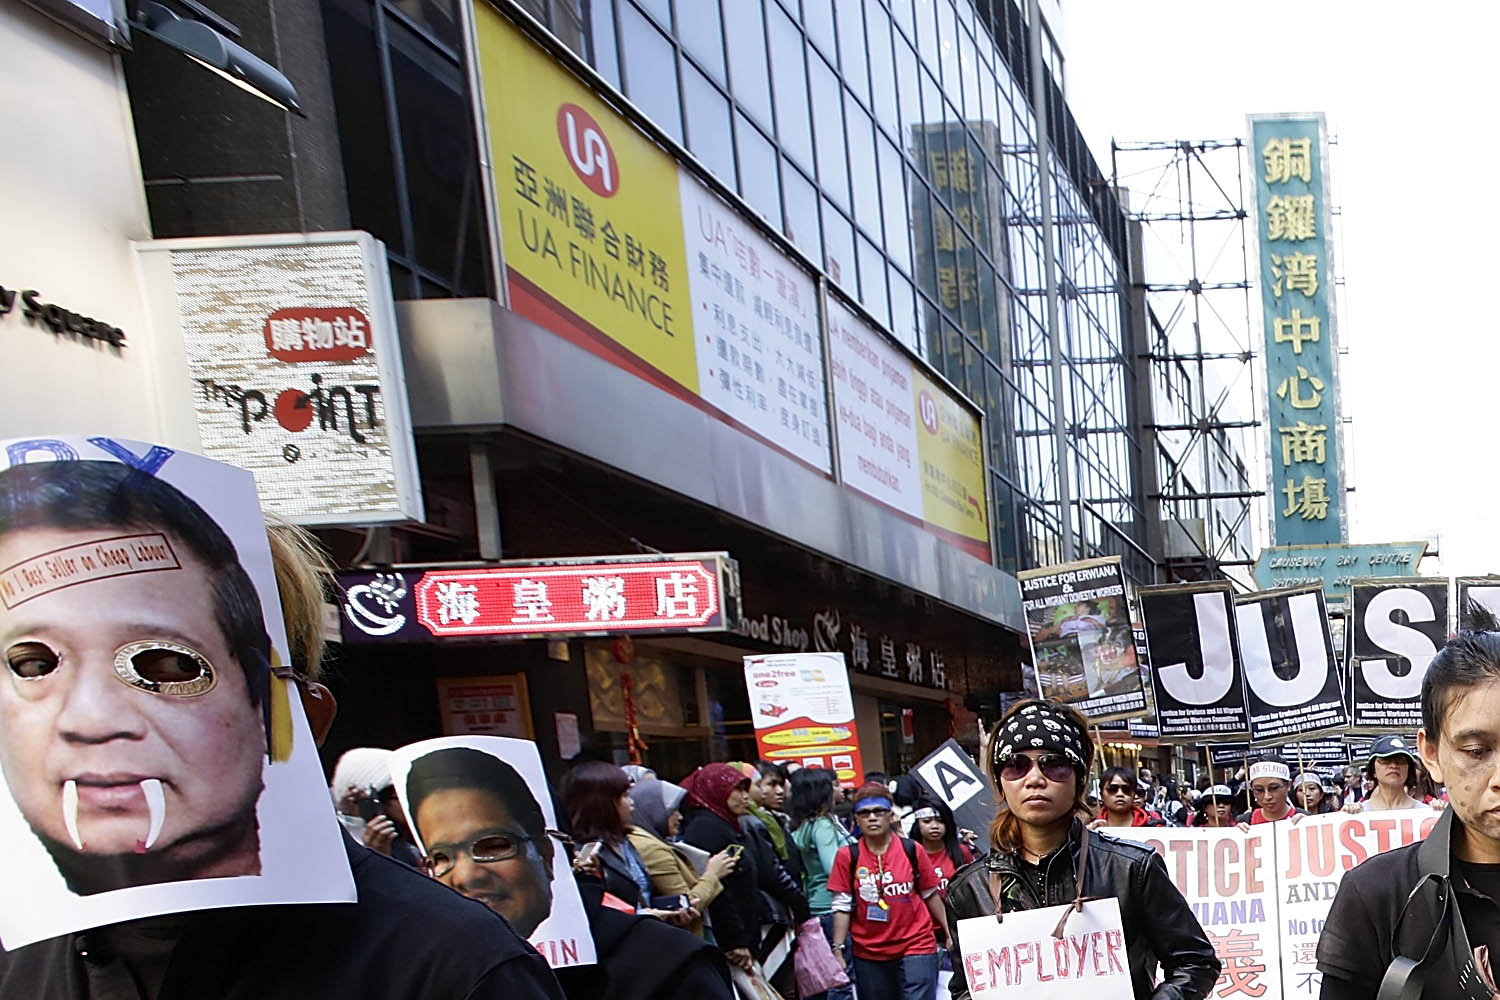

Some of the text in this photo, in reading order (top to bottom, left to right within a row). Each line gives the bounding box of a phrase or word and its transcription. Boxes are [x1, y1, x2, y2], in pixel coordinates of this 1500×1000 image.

[512, 153, 669, 293] 亞洲聯合財務
[518, 208, 675, 337] UA FINANCE
[269, 316, 368, 352] 購物站
[23, 543, 171, 587] Best Seller on Cheap Labour
[1023, 565, 1118, 592] JUSTICE FOR ERWIANA
[1269, 551, 1411, 569] CAUSEWAY BAY CENTRE
[436, 571, 700, 626] 海皇粥店
[1023, 599, 1035, 612] FOR
[1035, 597, 1046, 610] ALL
[1096, 585, 1123, 600] WORKERS
[1062, 584, 1074, 593] &
[735, 612, 809, 651] ood Shop
[850, 623, 946, 689] 海皇粥店
[935, 760, 976, 802] A
[1286, 882, 1339, 905] AND
[1288, 920, 1307, 936] No
[964, 928, 1126, 993] EMPLOYER
